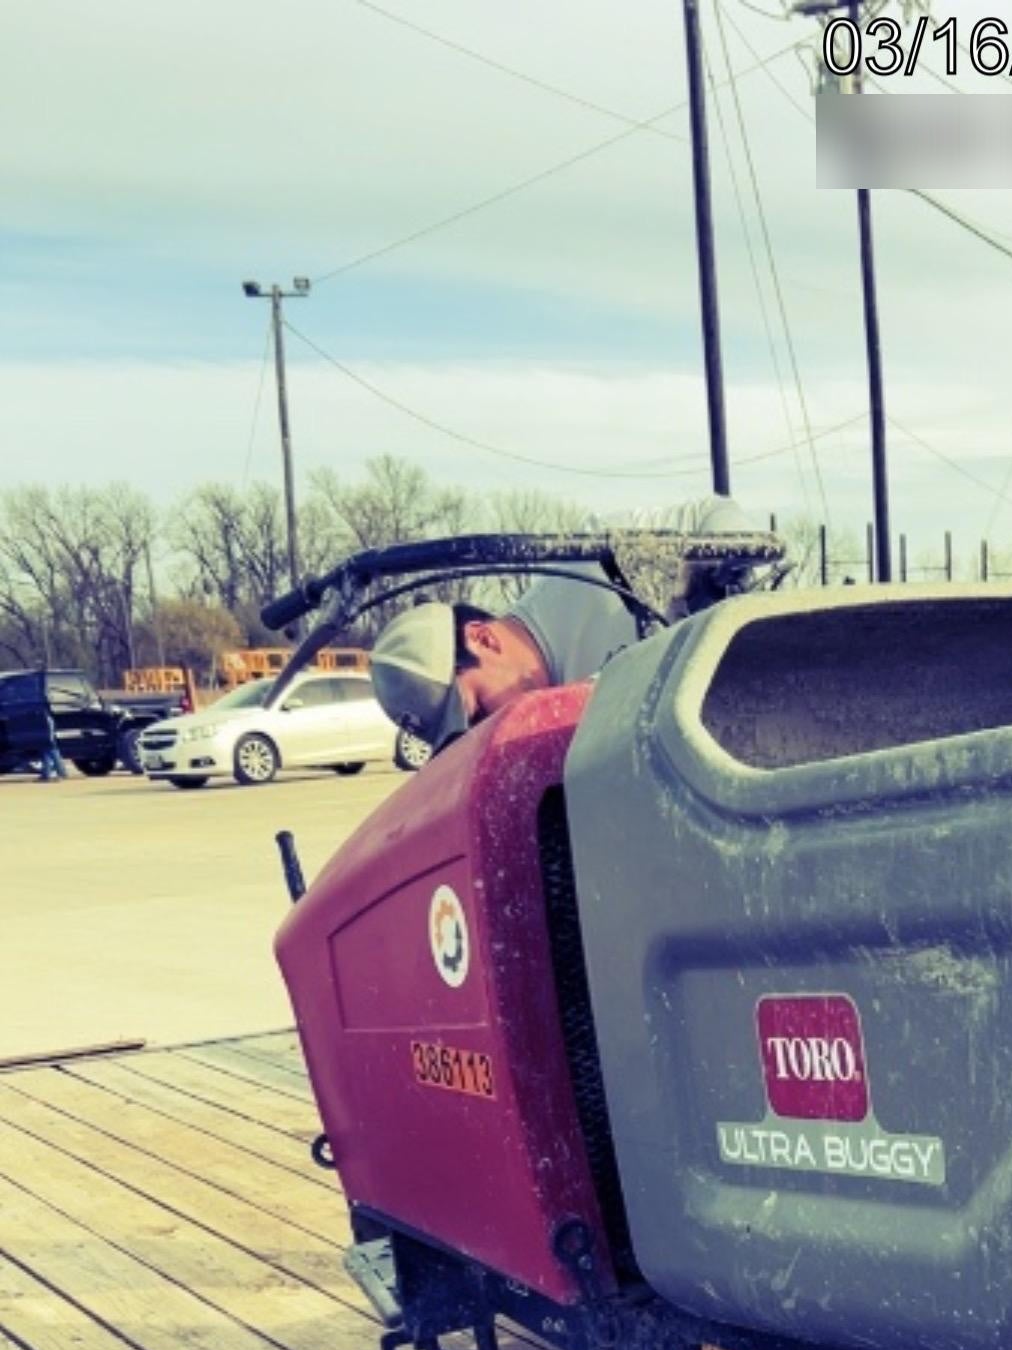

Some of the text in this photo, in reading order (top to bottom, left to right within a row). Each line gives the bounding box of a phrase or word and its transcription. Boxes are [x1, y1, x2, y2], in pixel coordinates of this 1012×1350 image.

[412, 1043, 494, 1096] 386113
[767, 1036, 857, 1082] TORO
[719, 1127, 936, 1178] ULTRA BUGGY
